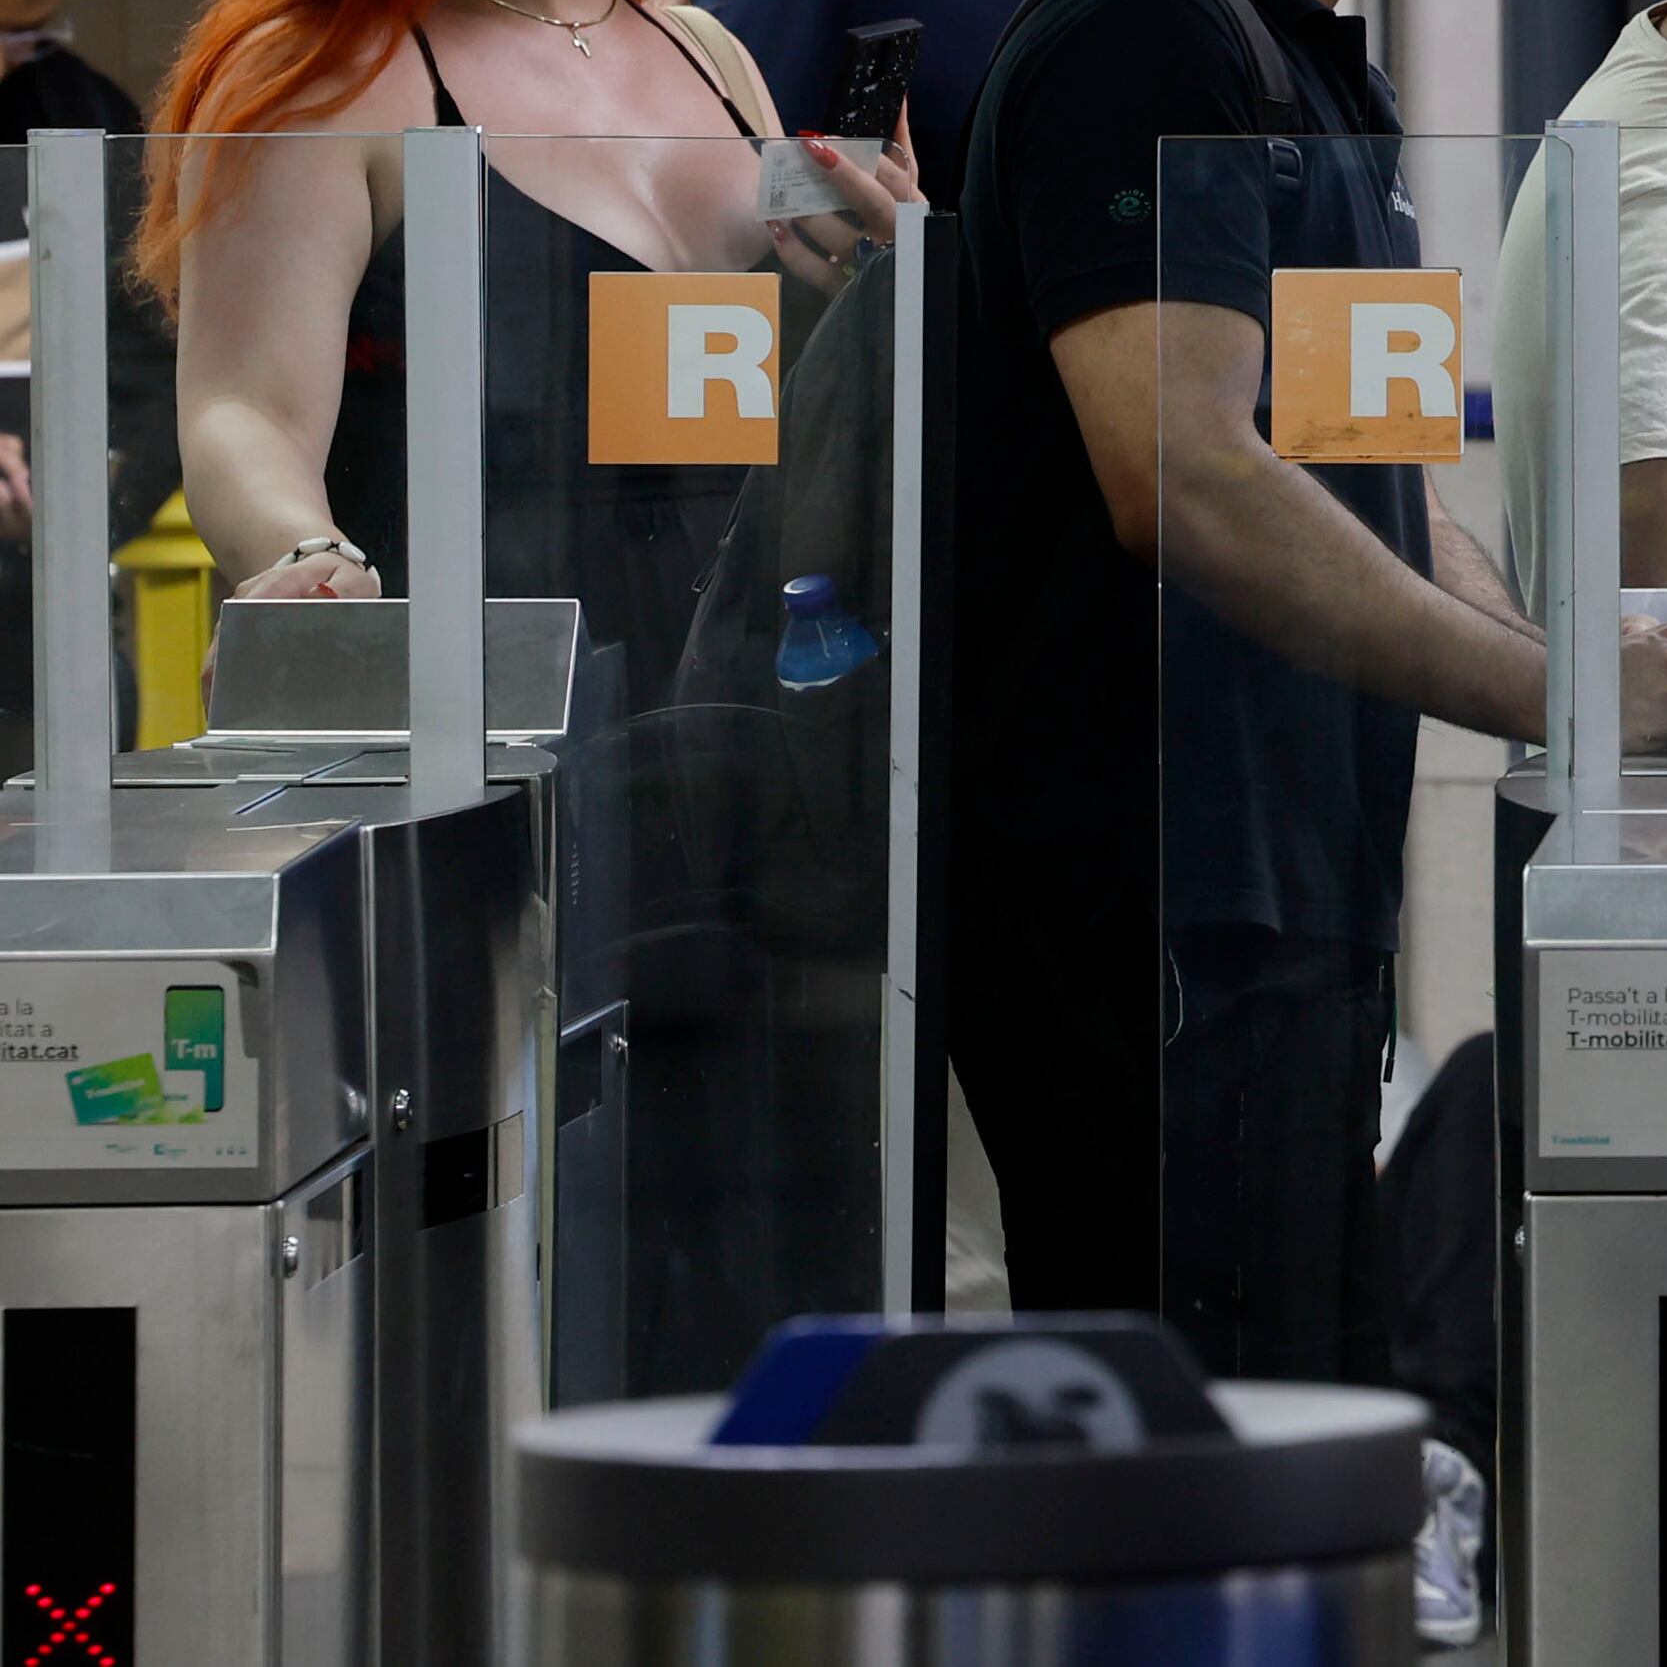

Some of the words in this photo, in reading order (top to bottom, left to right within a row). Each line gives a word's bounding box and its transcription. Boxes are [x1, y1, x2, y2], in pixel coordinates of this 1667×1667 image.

[667, 304, 776, 419] R
[1349, 302, 1457, 418] R
[1568, 986, 1640, 1005] Passa't
[1646, 991, 1658, 1005] a
[16, 997, 34, 1016] la
[41, 1023, 54, 1038] a
[0, 1042, 79, 1060] itat.cat
